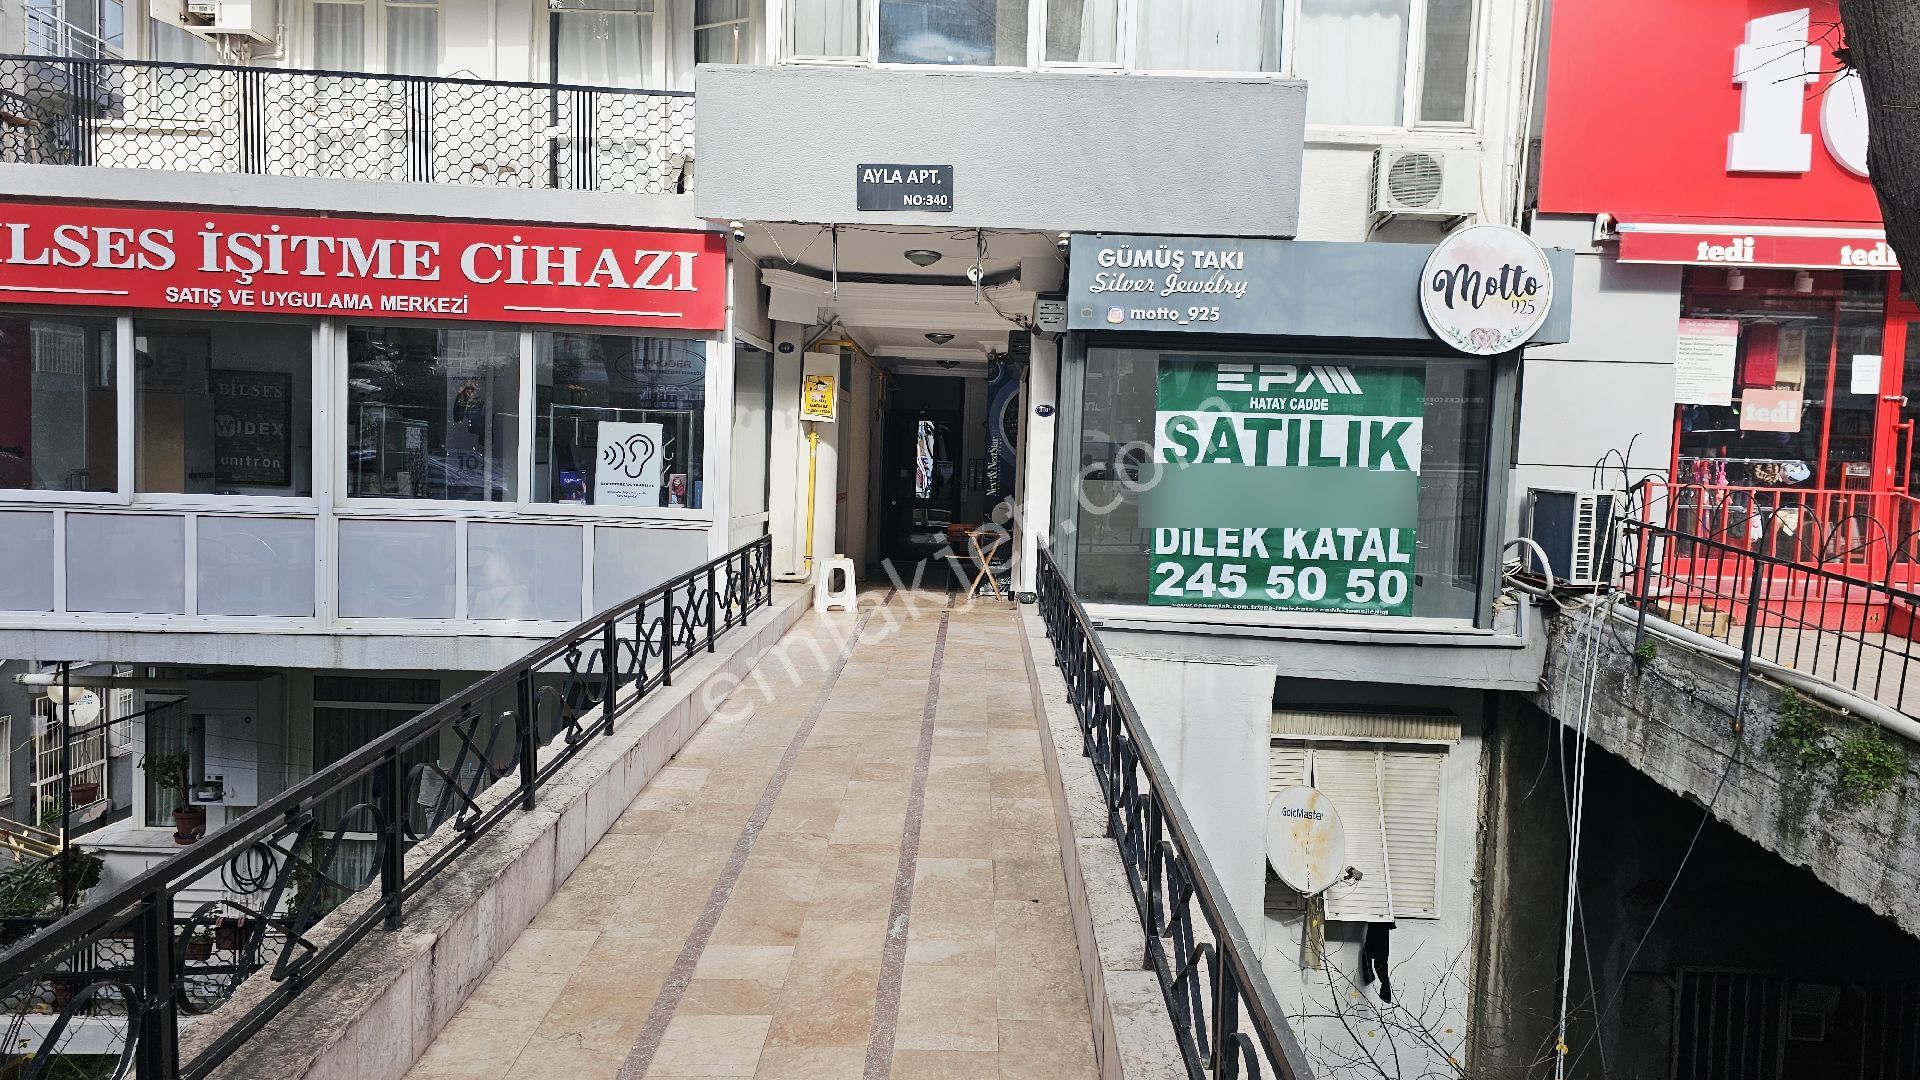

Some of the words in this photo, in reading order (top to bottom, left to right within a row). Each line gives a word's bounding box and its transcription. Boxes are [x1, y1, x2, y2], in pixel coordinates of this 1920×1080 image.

[863, 169, 902, 184] AYLA
[907, 169, 941, 185] APT.
[904, 194, 947, 206] NO:340
[0, 222, 176, 271] LSES
[198, 221, 440, 285] İŞİTME
[460, 235, 698, 292] CİHAZI
[1098, 245, 1185, 273] GÜMÜŞ
[1192, 251, 1244, 270] TAKI
[1697, 237, 1755, 262] tedi
[1090, 272, 1155, 294] Silver
[1160, 273, 1248, 298] Jewelry
[1433, 264, 1543, 309] Motto
[166, 287, 222, 308] SATIŞ
[229, 290, 254, 306] VE
[262, 290, 373, 310] UYGULAMA
[381, 294, 468, 314] MERKEZİ
[1511, 299, 1535, 315] 925
[1130, 307, 1220, 325] motto_925
[1249, 397, 1286, 410] HATAY
[1289, 398, 1329, 411] CADDE
[1746, 400, 1797, 423] tedi
[1162, 415, 1414, 471] SATILIK
[221, 456, 280, 469] unitron
[1155, 528, 1270, 559] DİLEK
[1283, 528, 1410, 563] KATAL
[1155, 561, 1248, 599] 245
[1265, 565, 1327, 601] 50
[1345, 569, 1408, 605] 50
